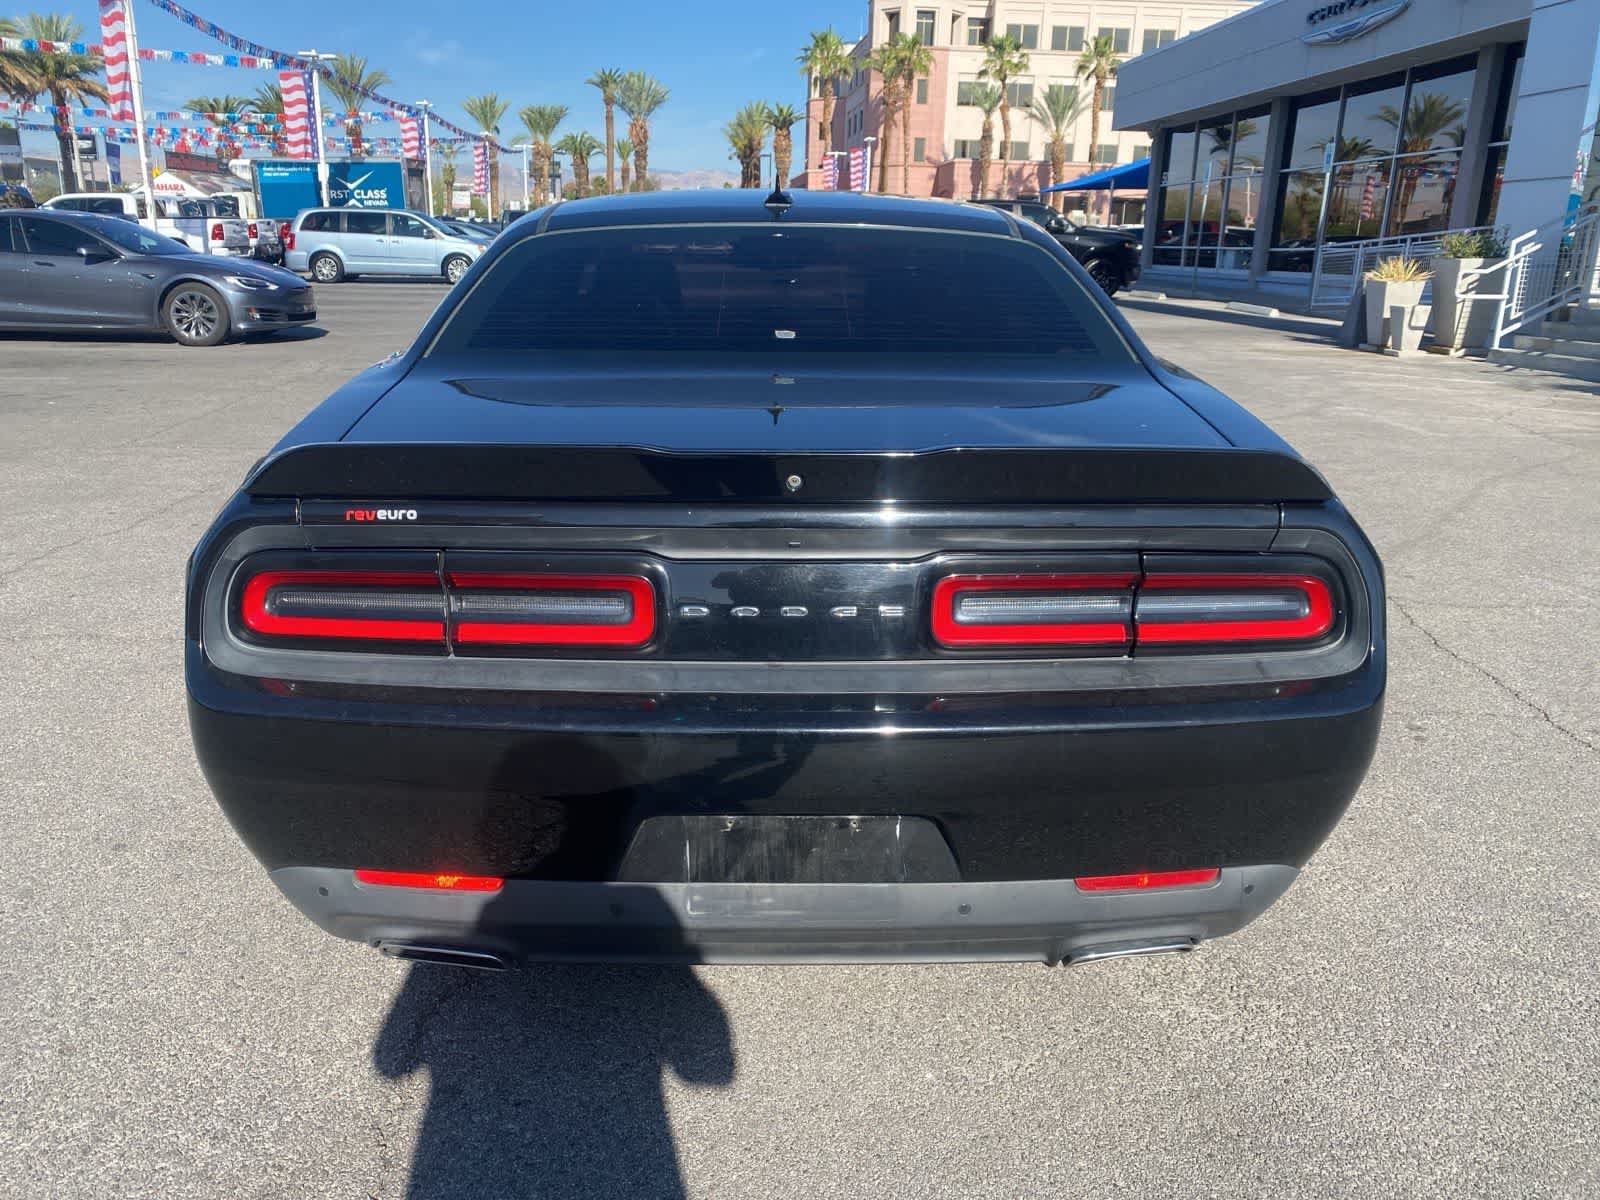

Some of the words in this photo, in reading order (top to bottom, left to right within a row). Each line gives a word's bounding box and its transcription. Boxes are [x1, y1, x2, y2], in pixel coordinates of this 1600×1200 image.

[153, 183, 186, 191] AHARA
[353, 189, 387, 199] CLASS
[363, 199, 389, 207] NEVADA
[345, 508, 418, 521] reveuro
[679, 605, 905, 617] DODGE
